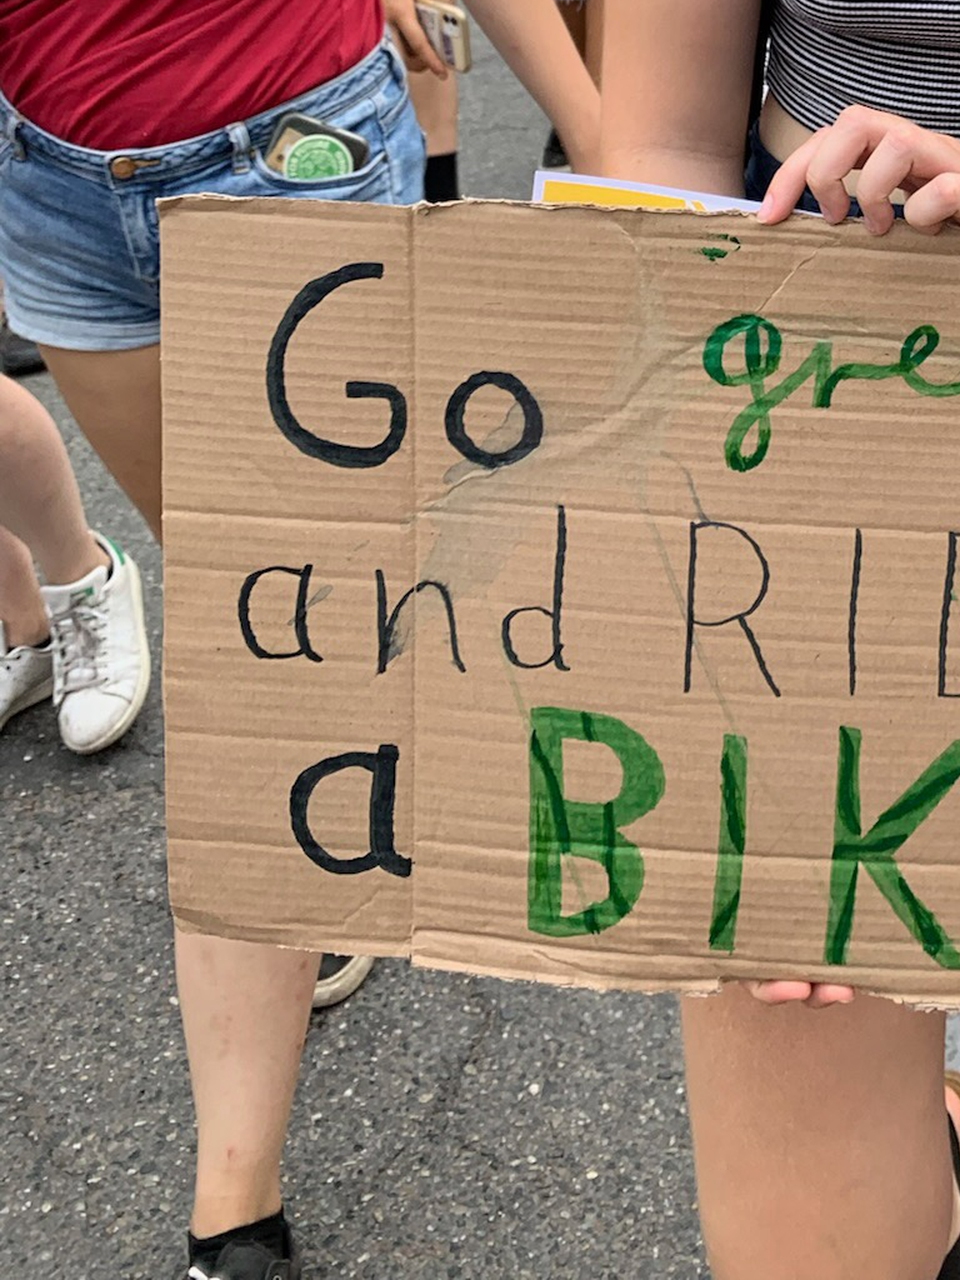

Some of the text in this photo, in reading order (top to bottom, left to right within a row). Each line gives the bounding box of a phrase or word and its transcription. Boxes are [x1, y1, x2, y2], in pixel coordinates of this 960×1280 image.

[266, 262, 545, 469] Go
[236, 504, 571, 675] and
[289, 743, 413, 877] a
